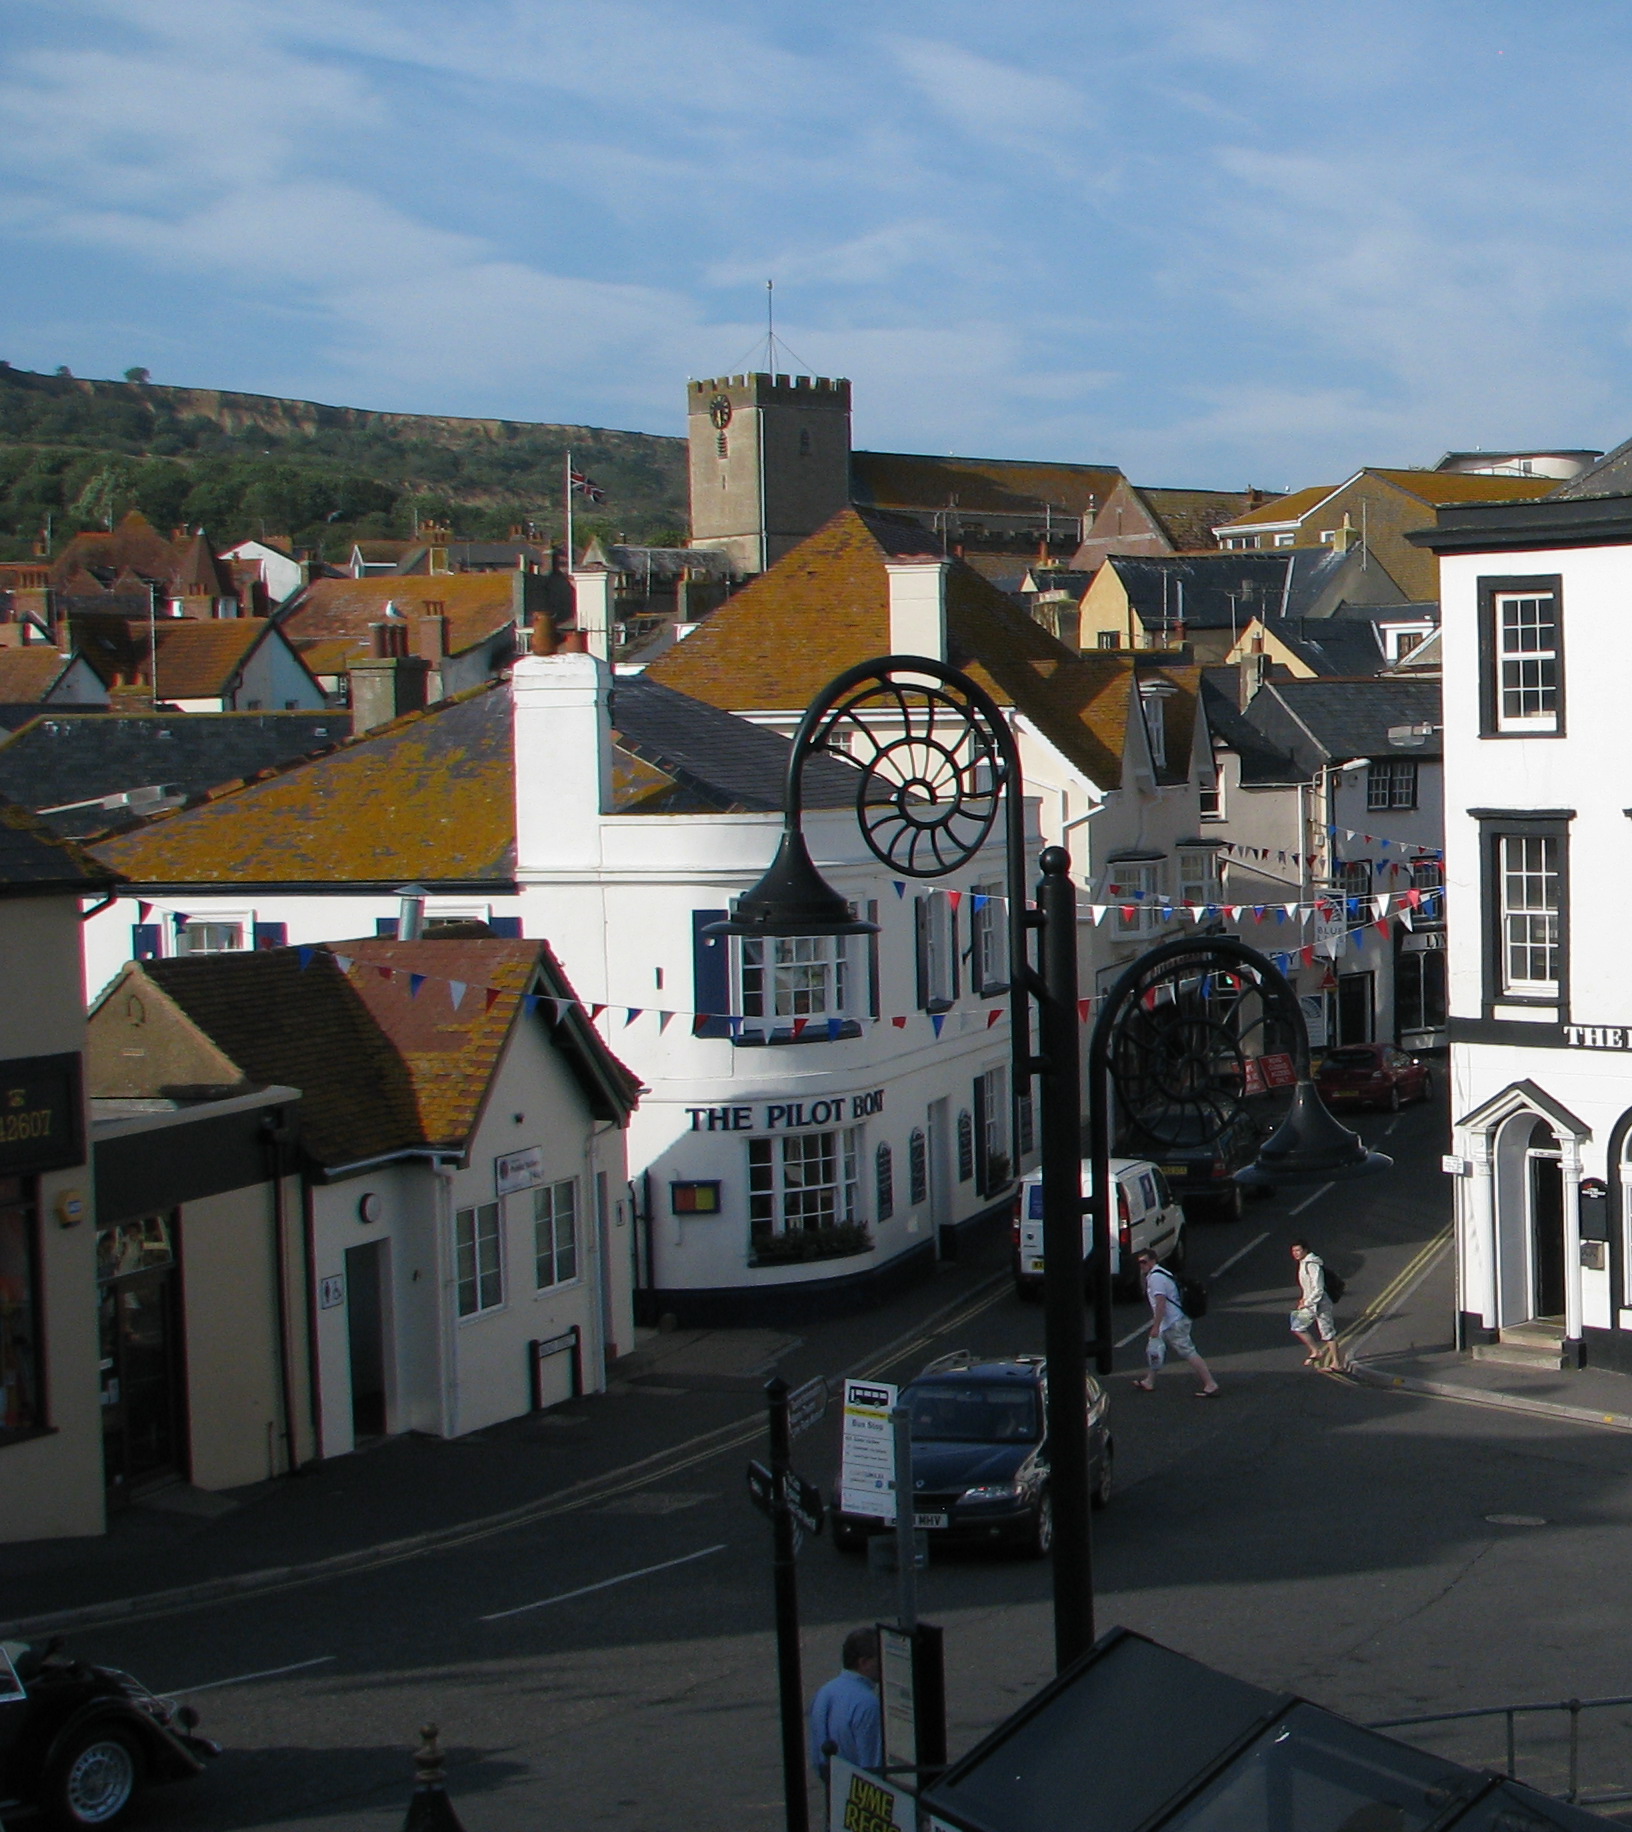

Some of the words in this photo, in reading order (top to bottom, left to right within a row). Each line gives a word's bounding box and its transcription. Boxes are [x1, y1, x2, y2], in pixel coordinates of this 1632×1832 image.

[1317, 926, 1342, 934] BLUE
[1564, 1026, 1622, 1047] THE
[686, 1106, 752, 1131] THE
[767, 1098, 846, 1129] PILOT
[853, 1089, 884, 1118] BOAT
[850, 1774, 895, 1821] LYME
[845, 1802, 901, 1832] REG
